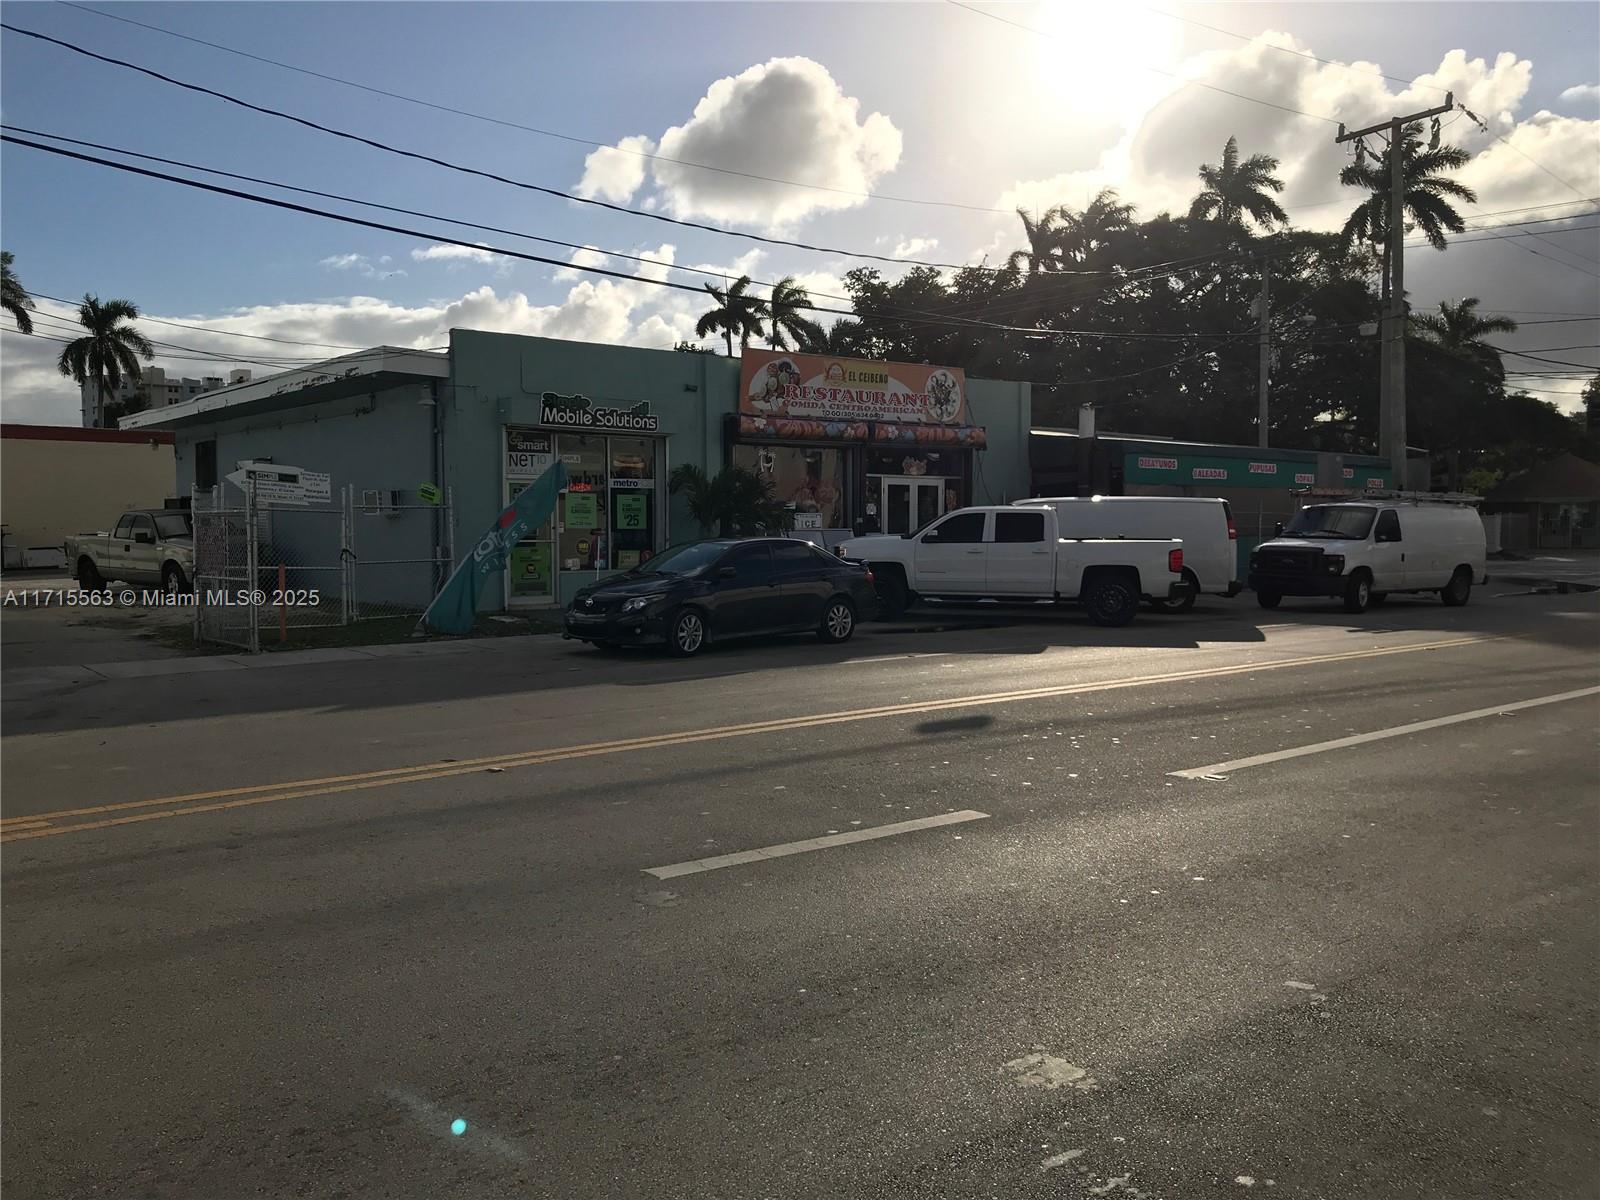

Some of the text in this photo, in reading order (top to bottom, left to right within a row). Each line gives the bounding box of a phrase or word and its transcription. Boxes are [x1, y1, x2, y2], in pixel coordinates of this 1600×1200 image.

[849, 371, 857, 382] EL
[784, 383, 930, 408] RESTAURANT
[785, 399, 826, 410] COMIDA
[544, 407, 656, 429] Mobile Solutions
[517, 440, 550, 451] smart
